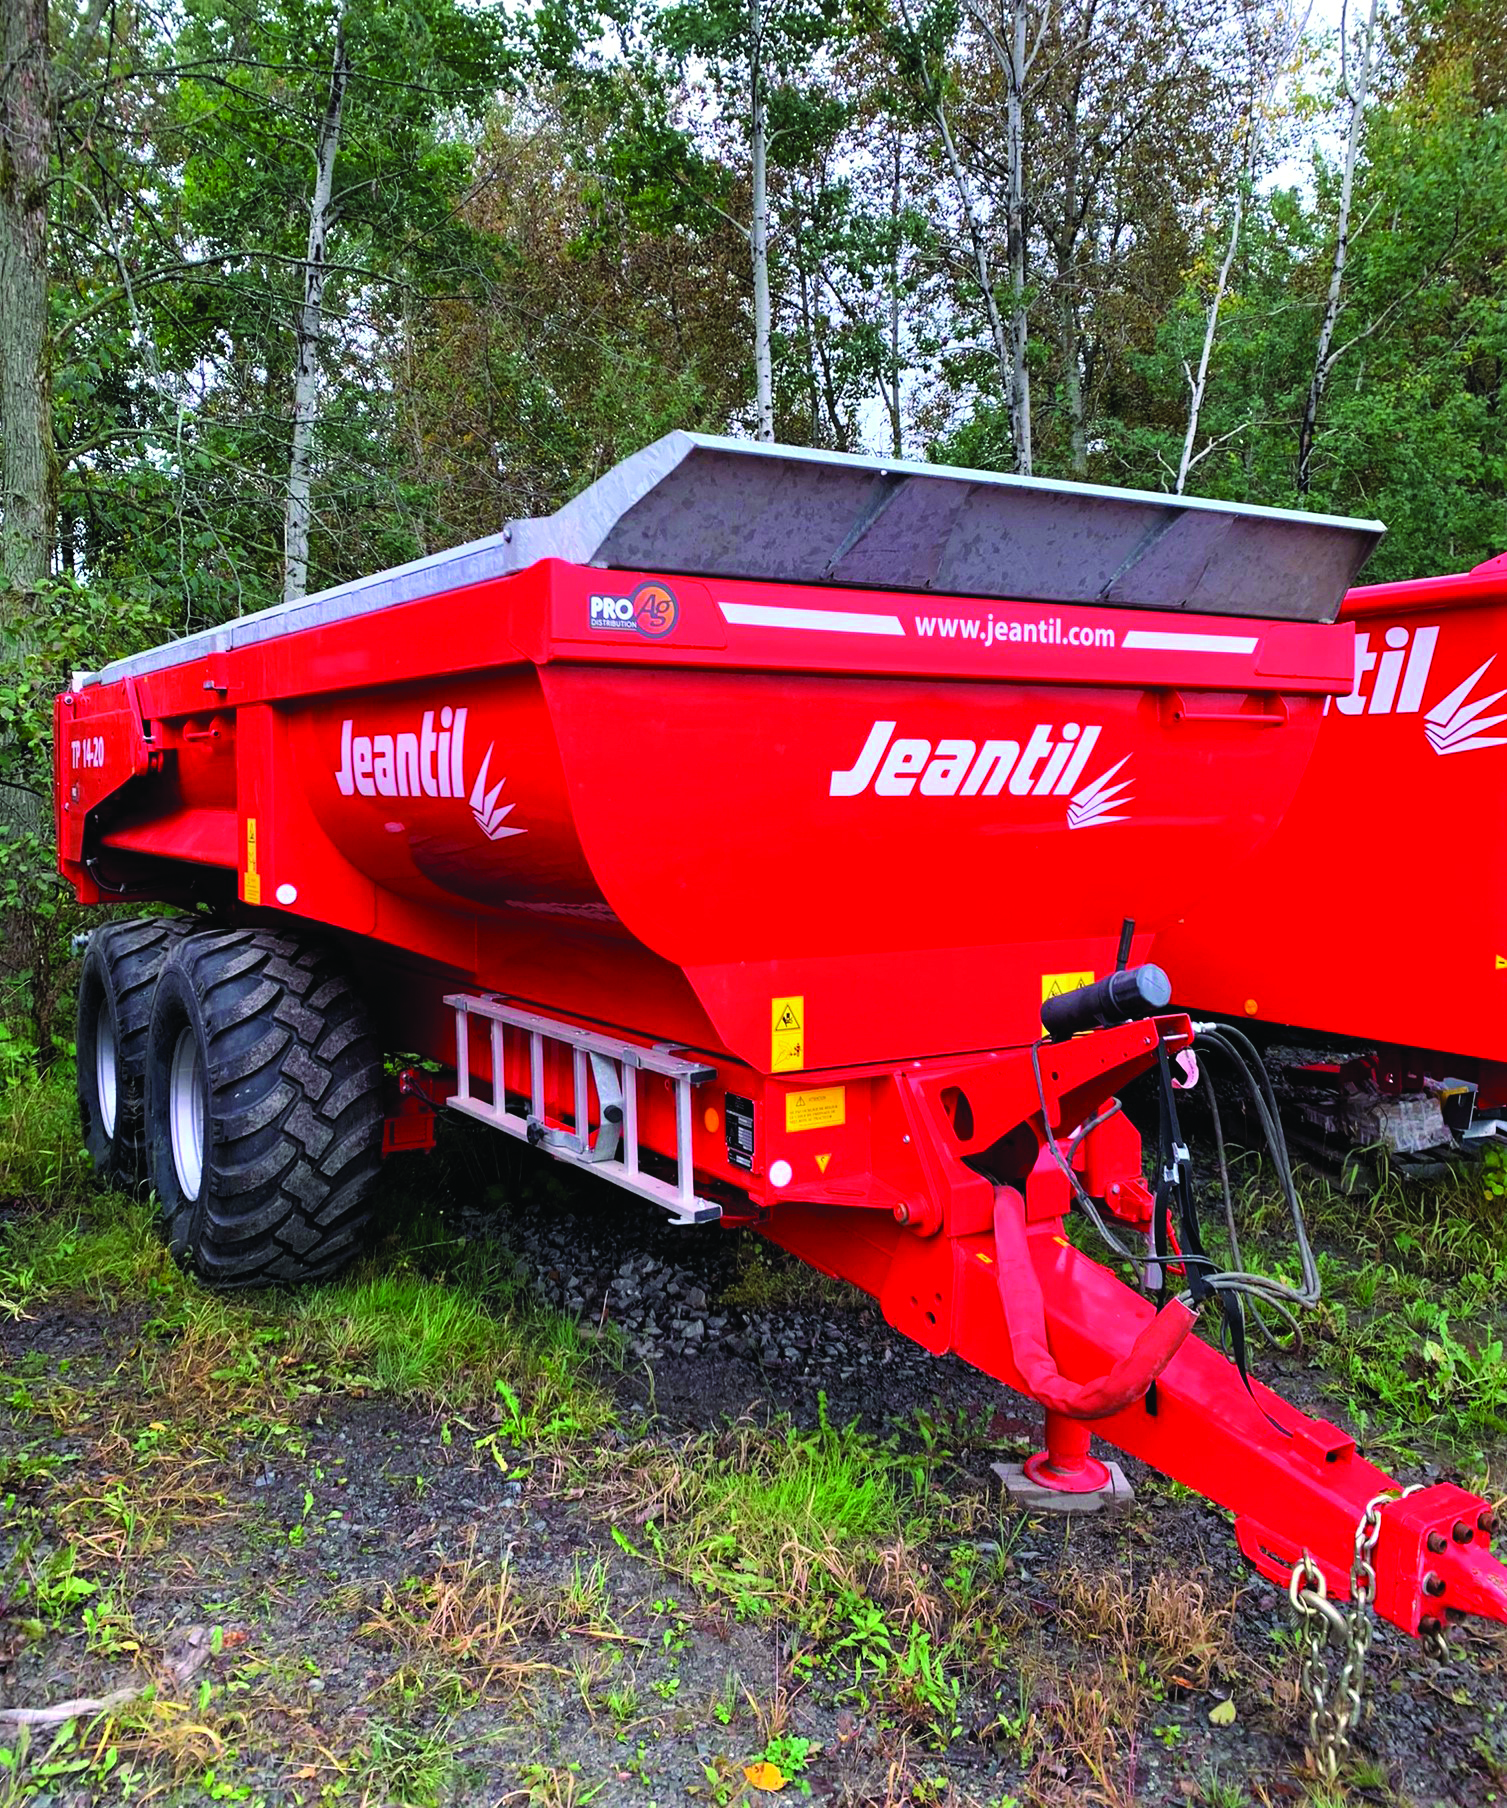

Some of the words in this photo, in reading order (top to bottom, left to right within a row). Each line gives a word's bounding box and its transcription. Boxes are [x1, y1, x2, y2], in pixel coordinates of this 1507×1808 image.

[590, 596, 634, 620] PRO
[637, 594, 673, 627] Ag
[591, 619, 637, 629] DISTRIBUTION
[915, 613, 1115, 647] www.jeantil.com
[1322, 626, 1440, 716] til
[71, 740, 81, 769] TP
[83, 736, 105, 769] 14-20
[335, 706, 468, 798] Jeantil
[829, 721, 1102, 796] Jeantil
